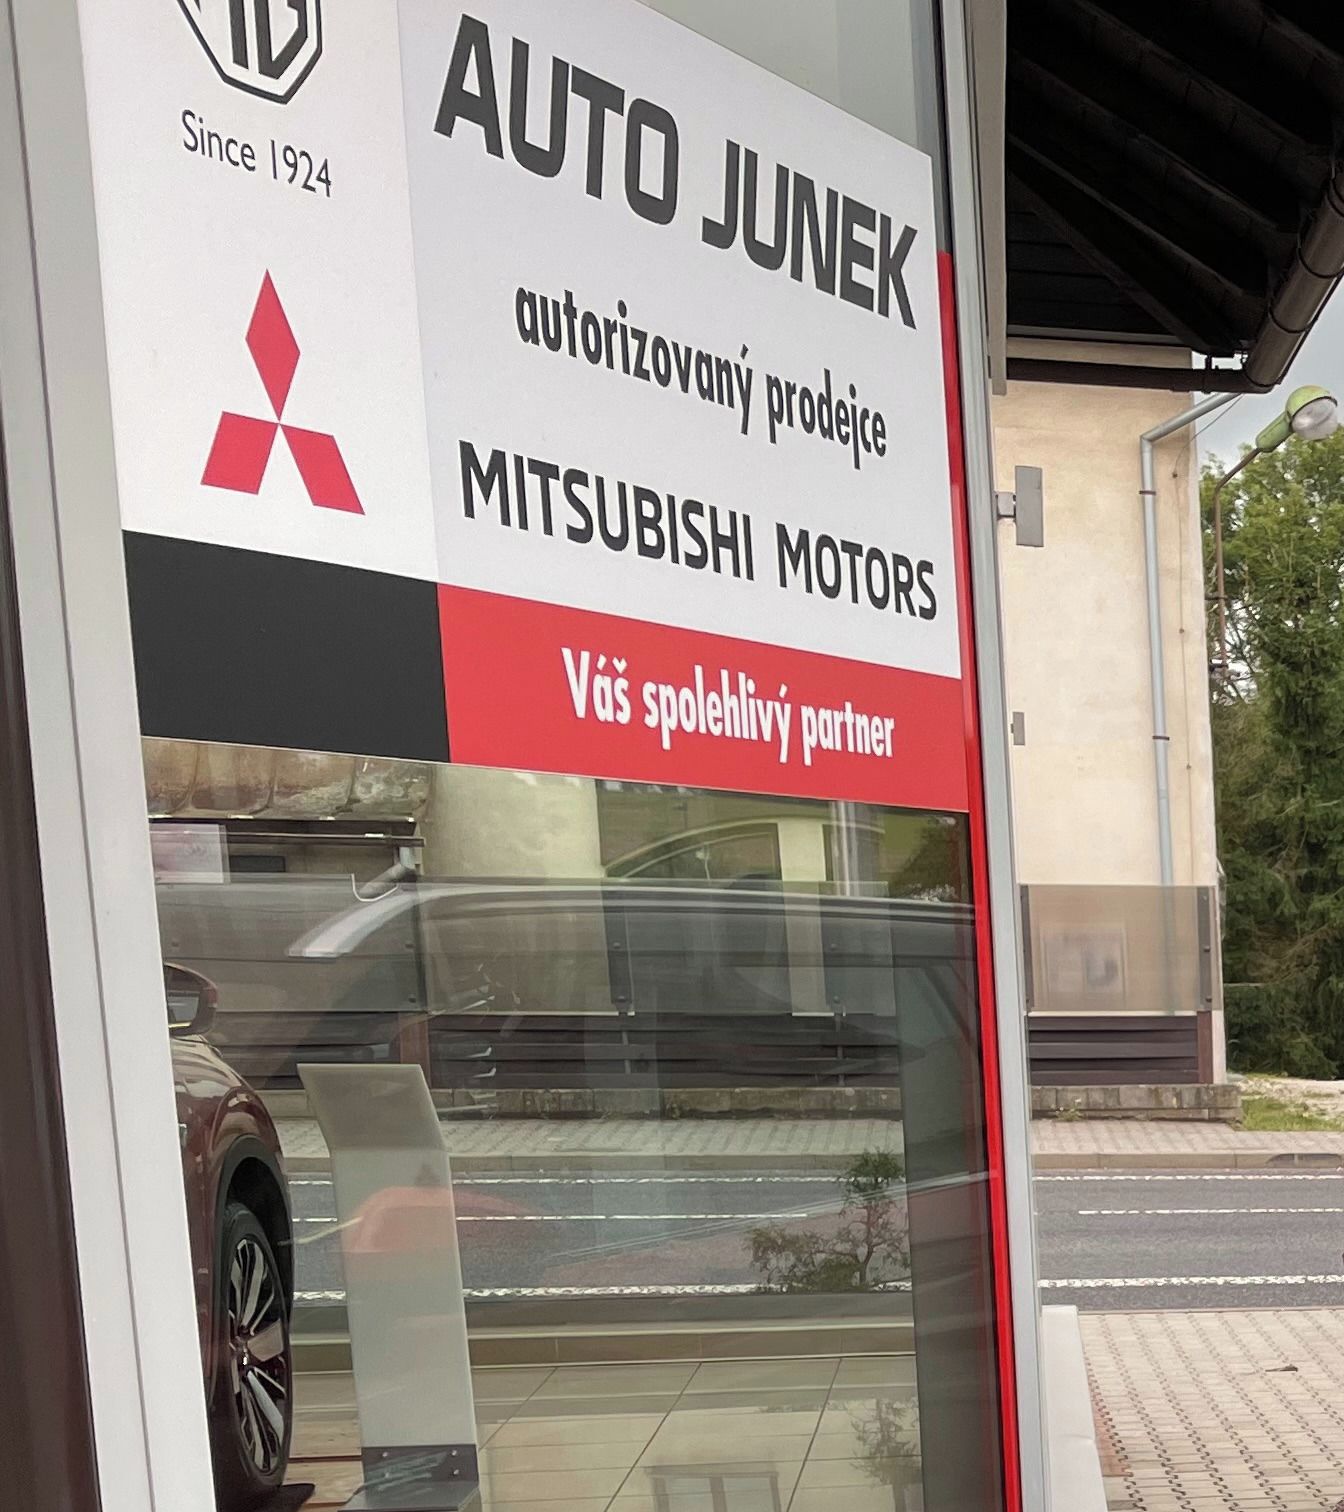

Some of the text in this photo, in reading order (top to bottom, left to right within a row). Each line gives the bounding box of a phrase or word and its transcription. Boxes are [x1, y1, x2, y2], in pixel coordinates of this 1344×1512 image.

[182, 109, 332, 198] Since 1924
[433, 13, 918, 330] AUTO JUNEK
[515, 287, 887, 470] autorizovaný prodejce
[458, 439, 937, 621] MITSUBISHI MOTORS
[561, 647, 895, 769] Váš spolehlivý partner
